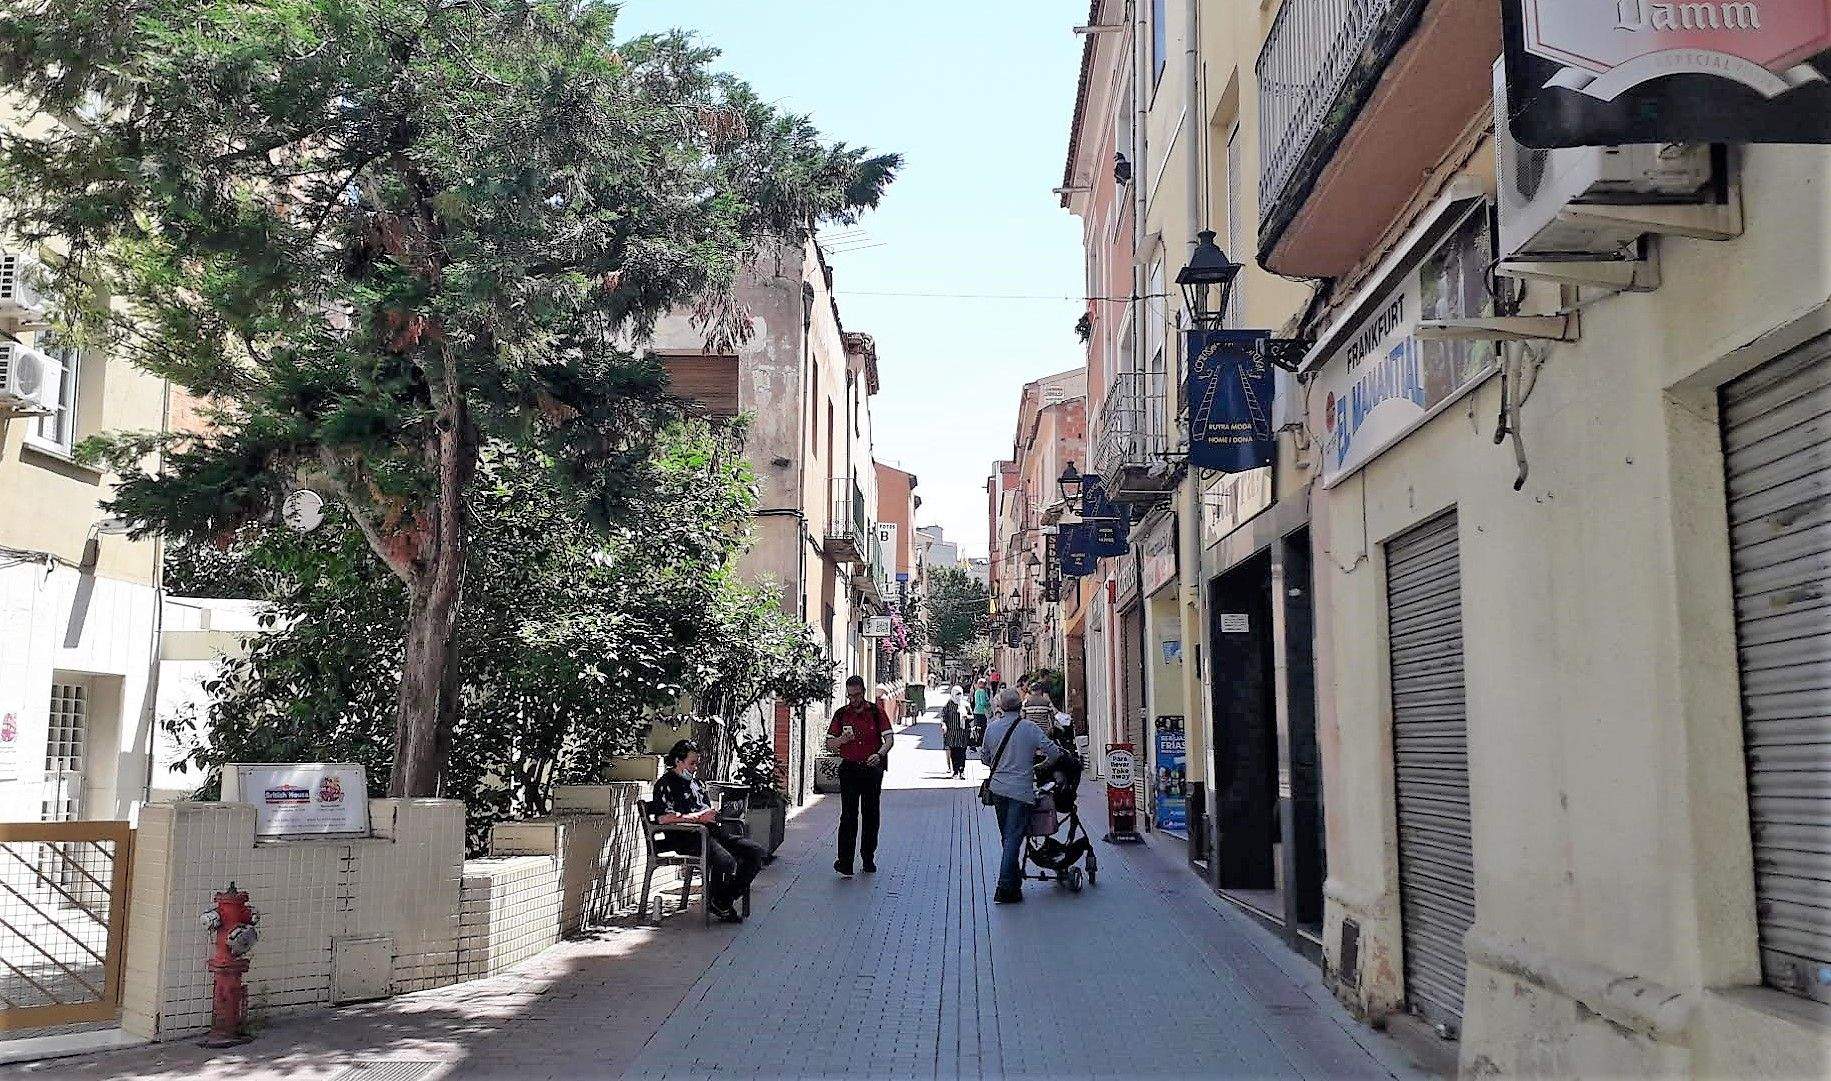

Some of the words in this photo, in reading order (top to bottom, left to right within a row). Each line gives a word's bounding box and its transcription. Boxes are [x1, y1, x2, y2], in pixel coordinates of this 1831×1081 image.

[1613, 0, 1761, 32] Damm
[1346, 293, 1405, 375] FRANKFURT
[1230, 423, 1253, 431] MODA
